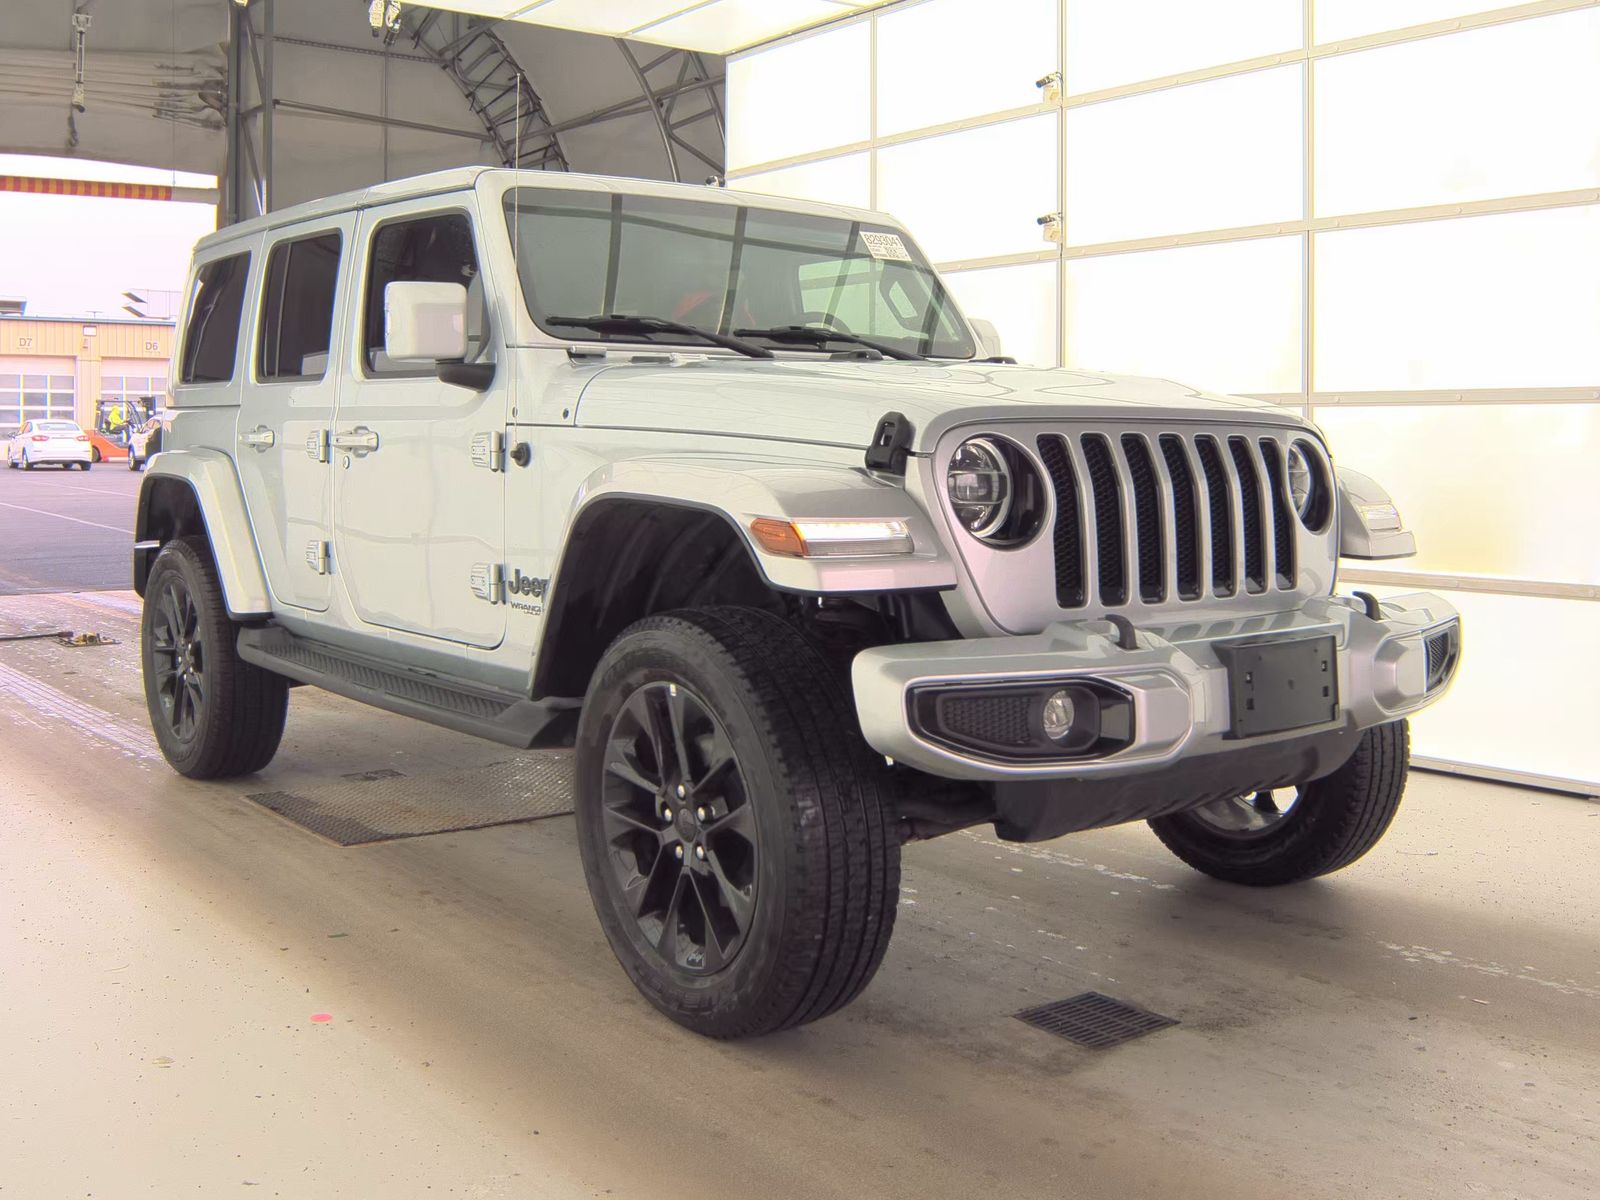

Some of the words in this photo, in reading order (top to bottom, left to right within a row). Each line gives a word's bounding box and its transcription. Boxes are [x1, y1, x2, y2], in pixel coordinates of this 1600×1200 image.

[863, 233, 903, 247] 8293041
[19, 338, 32, 347] D7
[145, 342, 158, 351] D6
